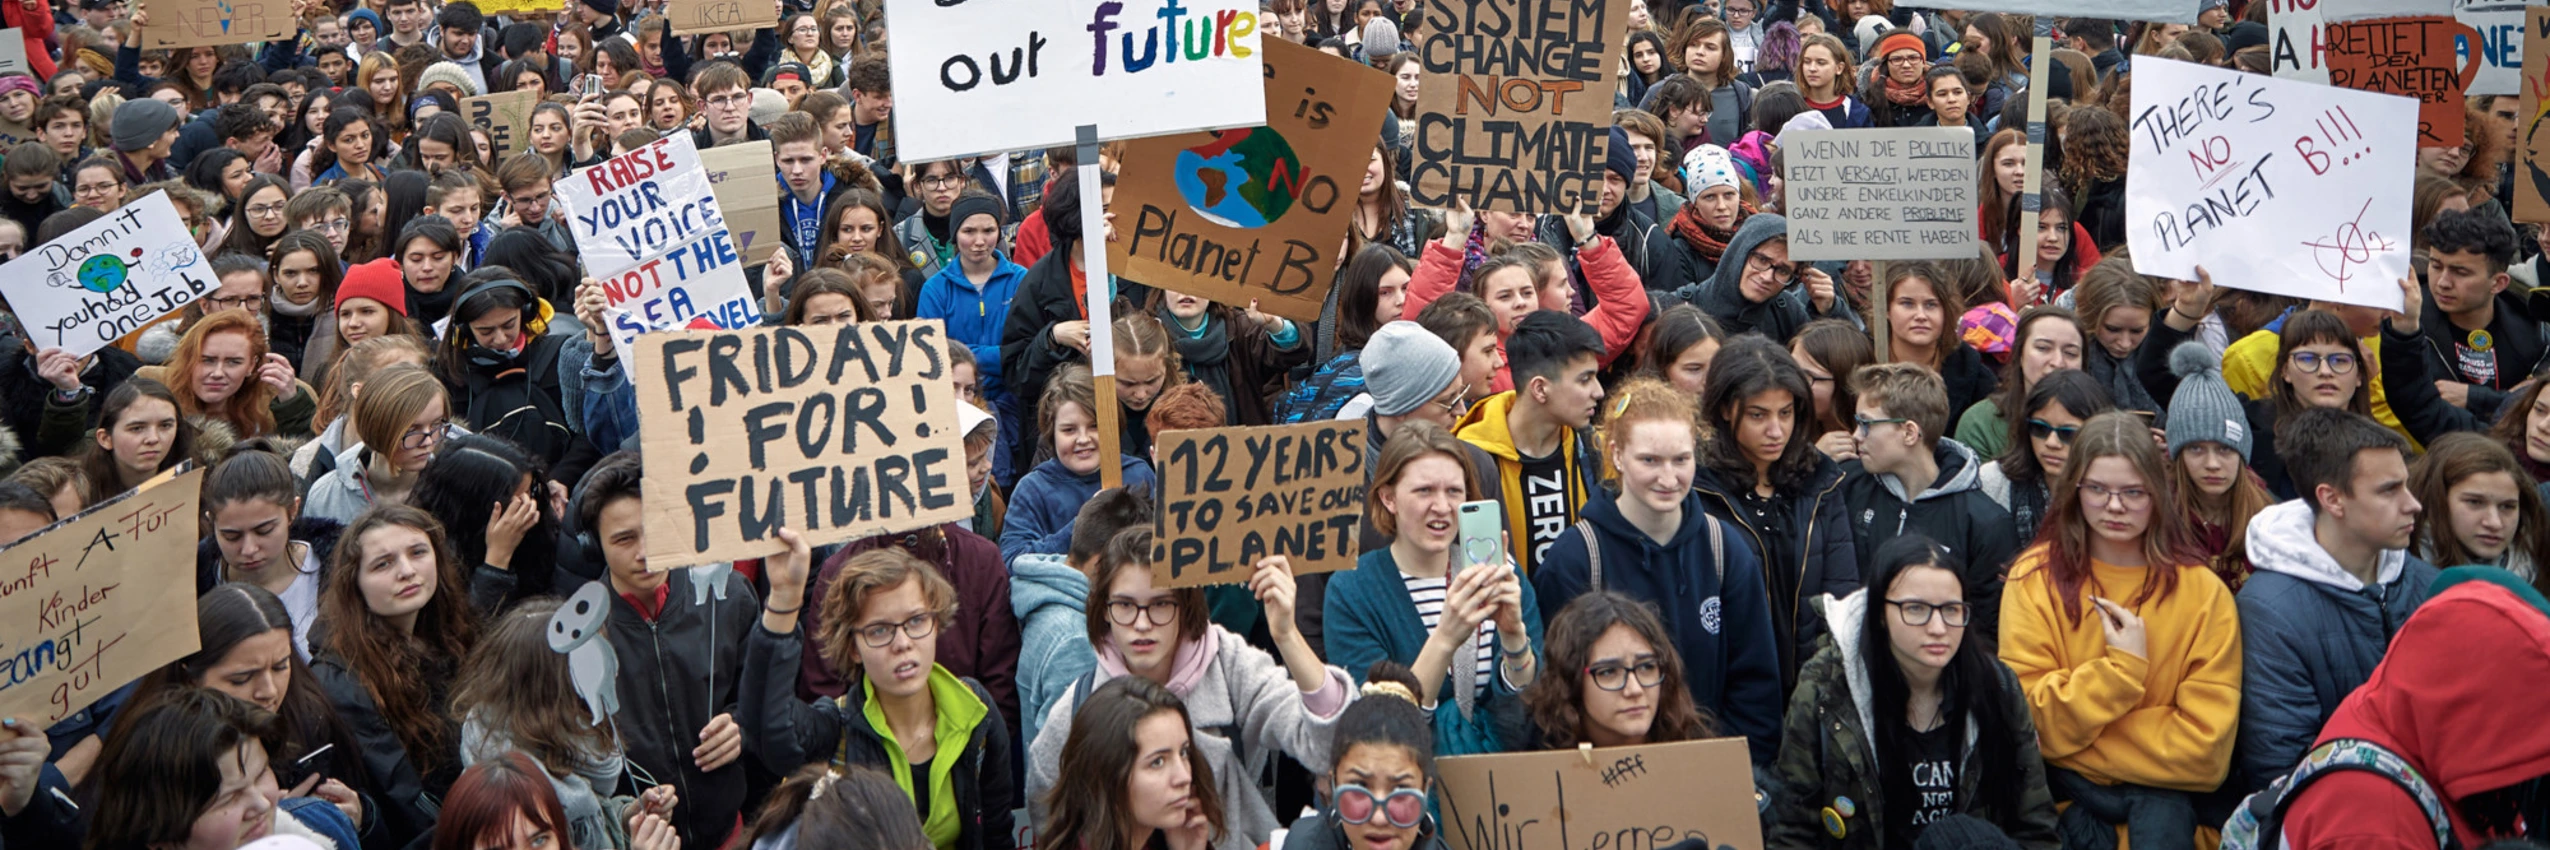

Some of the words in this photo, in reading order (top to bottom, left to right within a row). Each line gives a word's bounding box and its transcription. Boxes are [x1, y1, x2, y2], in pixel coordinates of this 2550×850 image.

[698, 2, 742, 26] IKEA
[1426, 0, 1606, 43] SYSTEM
[2325, 20, 2444, 57] RETTET
[940, 30, 1047, 92] our
[1086, 0, 1257, 76] future
[1422, 33, 1605, 82] CHANGE
[2273, 26, 2301, 73] A
[2367, 54, 2420, 69] DEN
[1456, 73, 1585, 117] NOT
[2329, 67, 2460, 91] PLANETEN
[1294, 87, 1336, 129] is
[2132, 75, 2275, 154] THERE'S
[586, 138, 675, 196] RAISE
[1417, 112, 1611, 172] CLIMATE
[1800, 140, 1860, 159] WENN
[1870, 140, 1897, 158] DIE
[1909, 140, 1970, 158] POLITIK
[2187, 135, 2231, 183] NO
[1268, 157, 1341, 214] NO
[1410, 161, 1606, 215] CHANGE
[1787, 166, 1826, 182] JETZT
[1908, 168, 1969, 182] WERDEN
[1797, 187, 1847, 201] UNSERE
[1859, 187, 1966, 202] ENKELKINDER
[578, 181, 667, 236] YOUR
[1792, 207, 1830, 220] GANZ
[1837, 207, 1892, 221] ANDERE
[1903, 206, 1966, 222] PROBLEME
[2153, 152, 2275, 252] PLANET
[38, 228, 120, 272] Damn
[116, 208, 143, 236] it
[1129, 203, 1261, 287] Planet
[1263, 239, 1320, 295] B
[1795, 229, 1823, 245] ALS
[1833, 231, 1858, 245] IHRE
[1865, 229, 1912, 245] RENTE
[1920, 230, 1970, 245] HABEN
[150, 272, 206, 313] Job
[602, 259, 662, 308] NOT
[666, 230, 738, 281] THE
[616, 286, 696, 344] SEA
[662, 323, 943, 412] FRIDAYS
[1171, 434, 1233, 495] 12
[1245, 428, 1363, 491] YEARS
[686, 448, 955, 553] FUTURE
[1169, 498, 1223, 534] TO
[1235, 487, 1316, 523] SAVE
[1319, 485, 1365, 511] OUR
[1171, 514, 1360, 579] PLANET
[0, 553, 59, 597] unft
[39, 583, 120, 634] Kinder
[50, 633, 127, 721] gut
[1436, 769, 1540, 850] Wir
